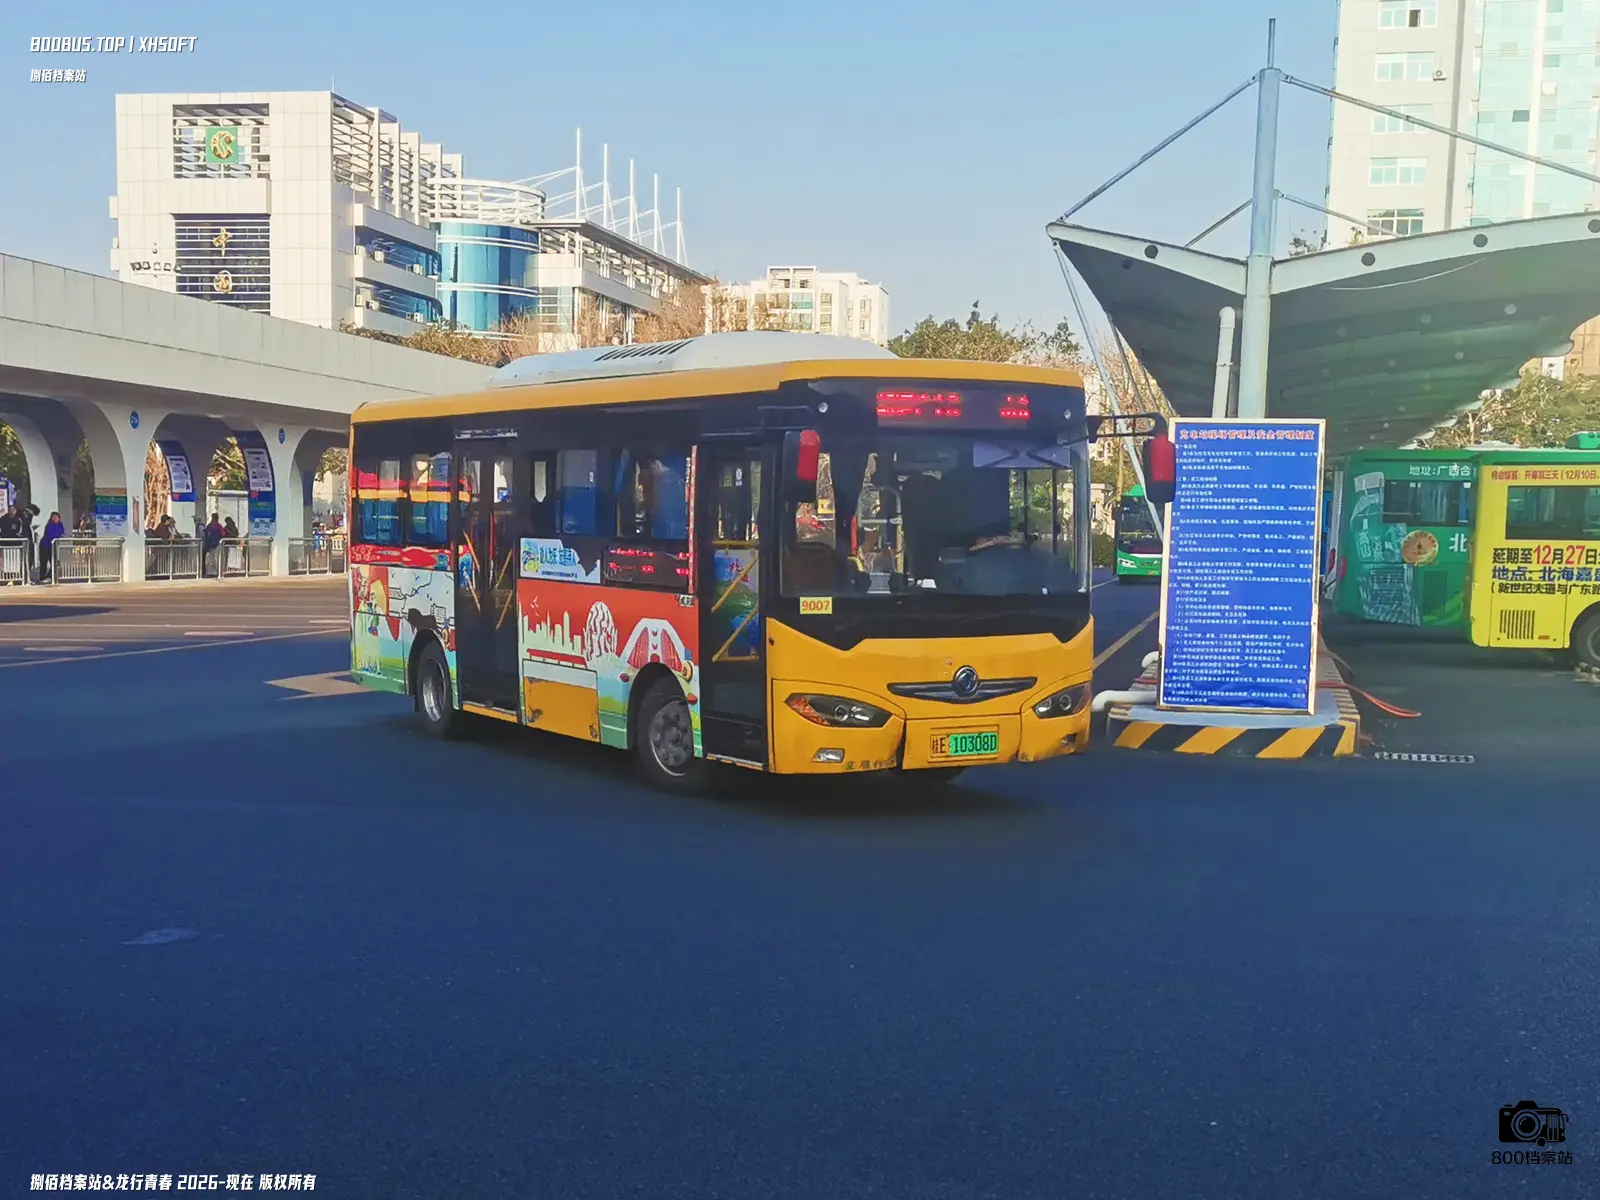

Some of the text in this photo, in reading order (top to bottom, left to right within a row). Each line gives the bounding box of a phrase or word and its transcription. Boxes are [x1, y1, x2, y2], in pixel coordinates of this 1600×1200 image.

[1409, 464, 1477, 477] 地址:广西合
[1492, 544, 1600, 565] 延期至12月27日
[801, 600, 830, 611] 9007
[954, 734, 997, 753] 10308D
